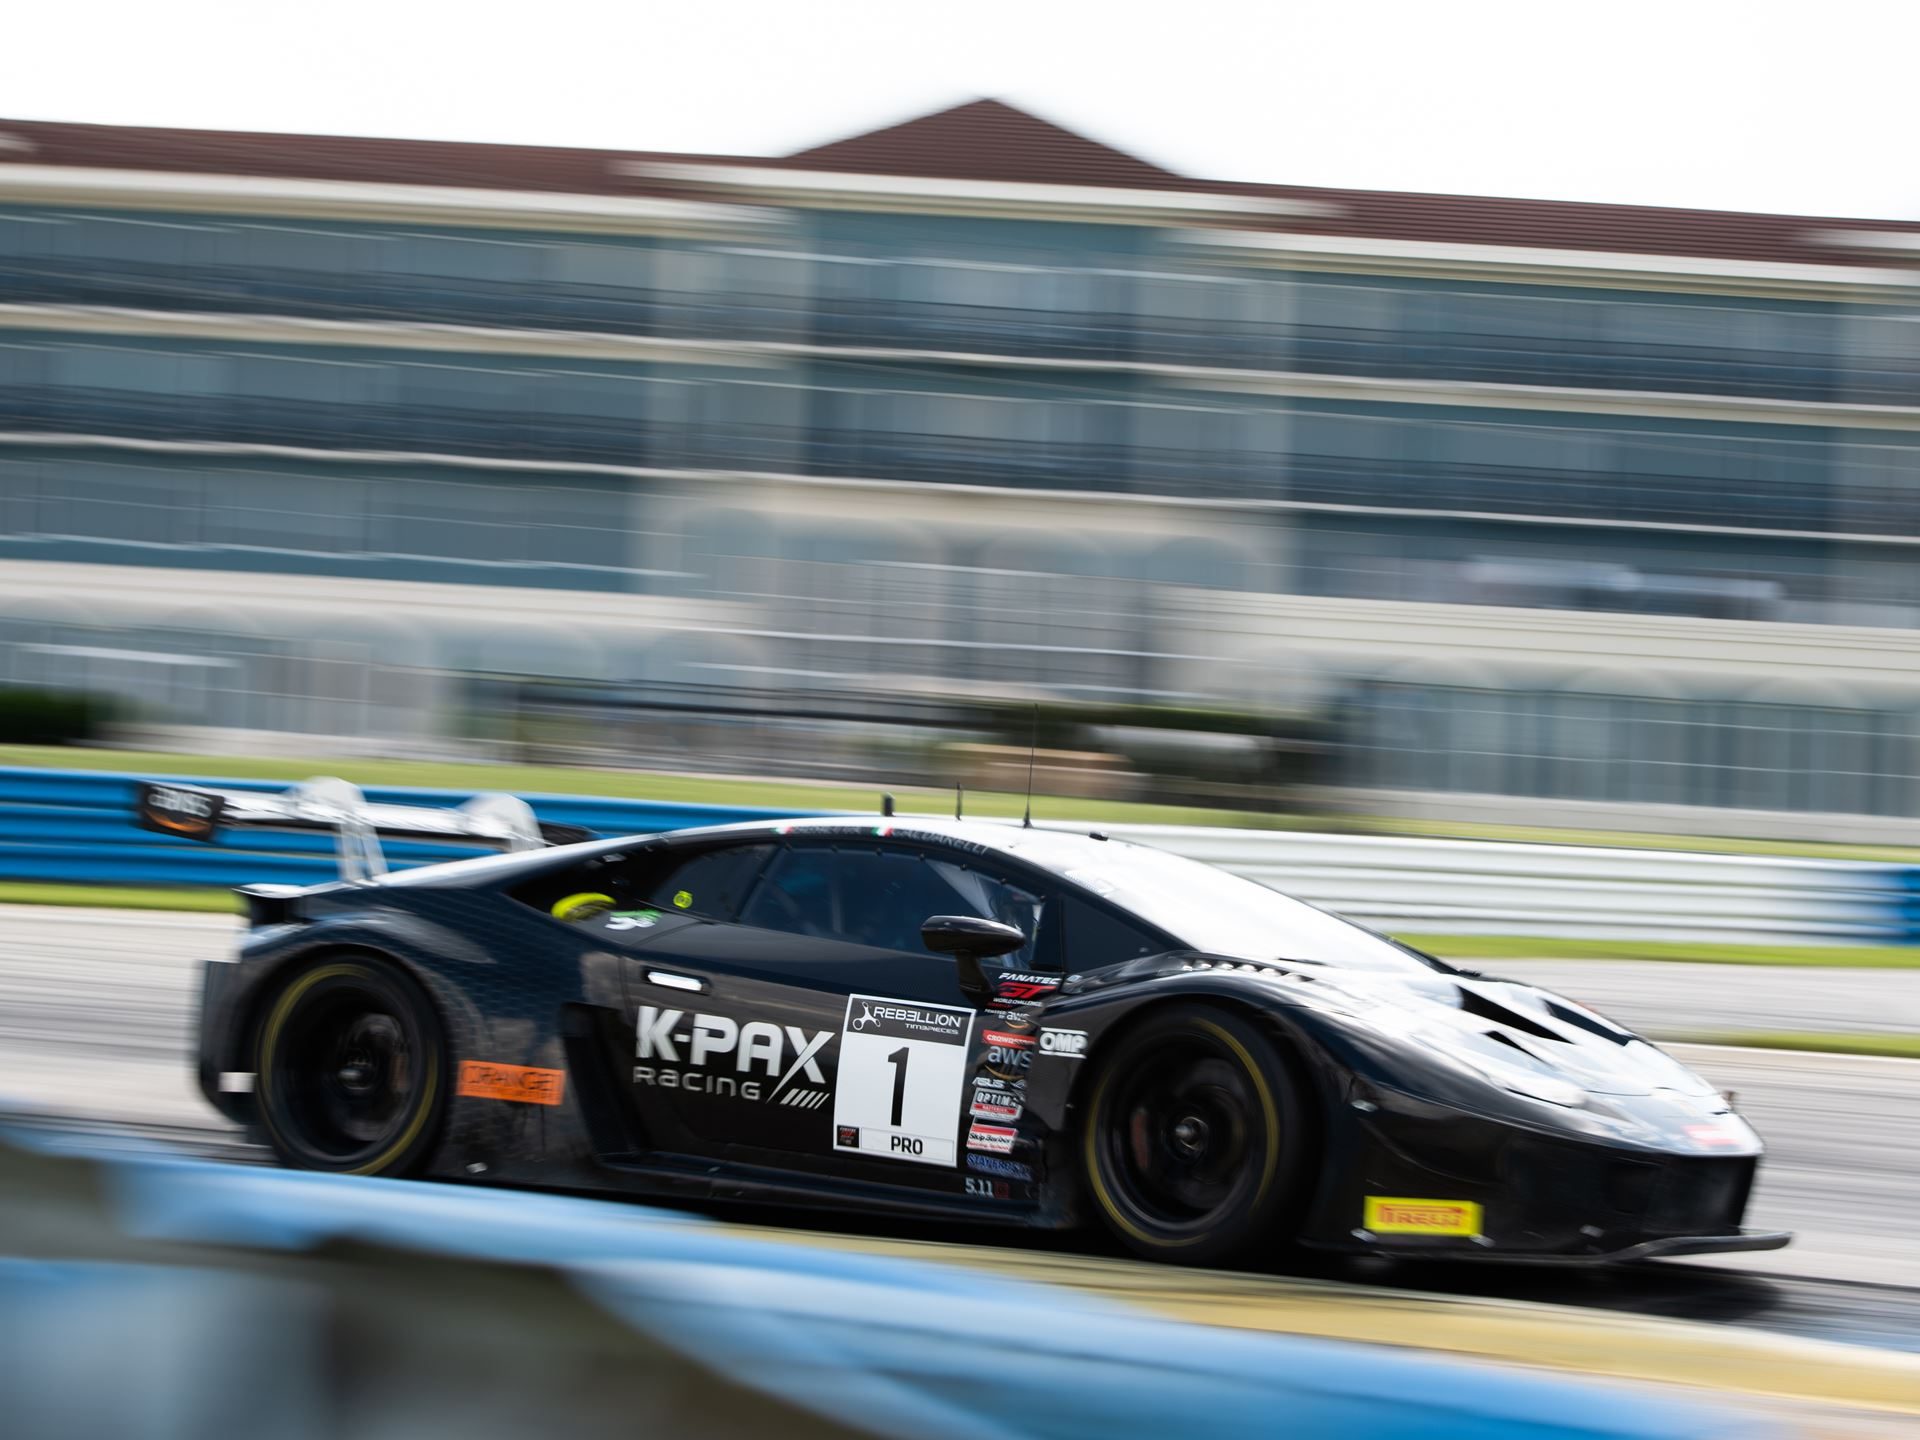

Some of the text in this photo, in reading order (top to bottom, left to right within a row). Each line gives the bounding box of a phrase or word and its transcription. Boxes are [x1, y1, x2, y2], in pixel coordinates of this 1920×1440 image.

[999, 972, 1062, 985] FANATEC
[873, 1006, 962, 1028] REBELLION
[1040, 1032, 1088, 1054] OMP
[635, 1005, 836, 1104] K-PAX
[987, 1045, 1035, 1069] aws
[887, 1046, 910, 1127] 1
[890, 1135, 923, 1155] PRO
